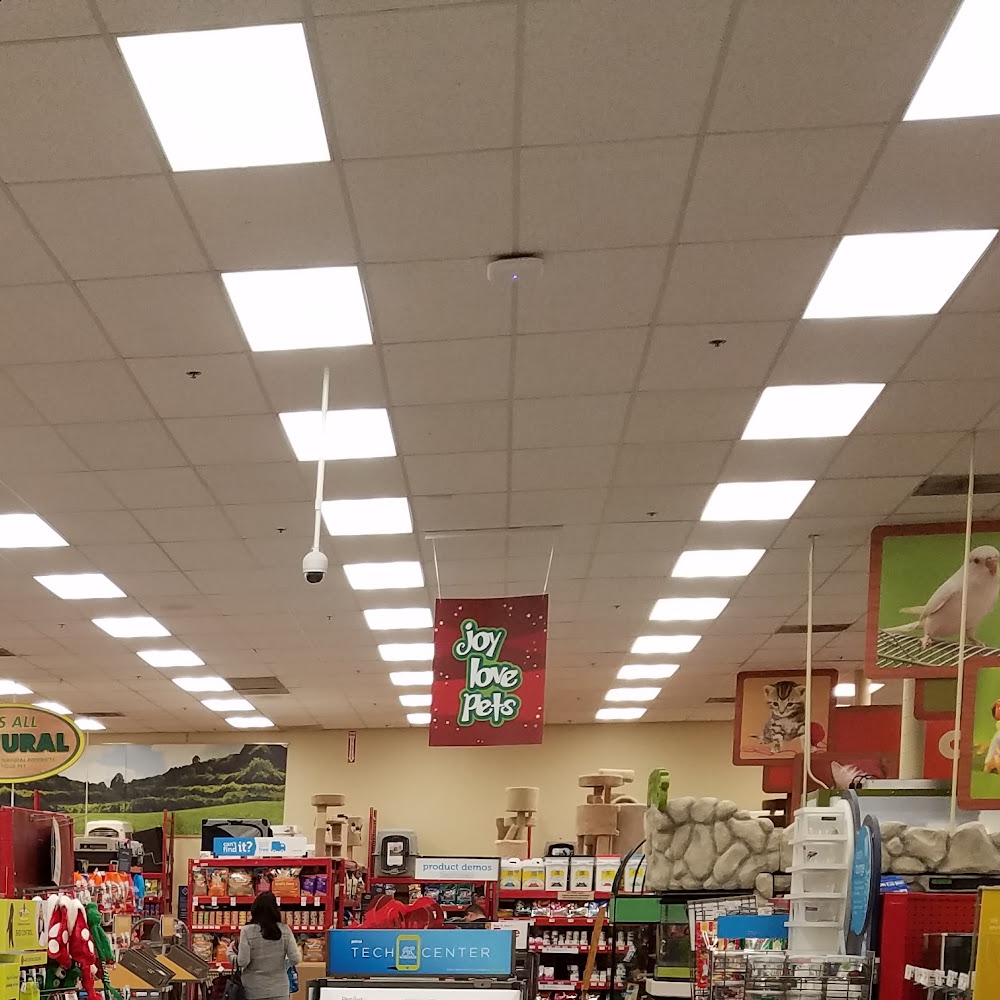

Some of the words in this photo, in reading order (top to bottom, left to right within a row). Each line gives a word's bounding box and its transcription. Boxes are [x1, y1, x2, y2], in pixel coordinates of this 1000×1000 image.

[456, 621, 502, 657] joy
[470, 657, 518, 688] love
[12, 716, 37, 728] ALL
[223, 845, 237, 853] find
[237, 841, 253, 852] it?
[422, 862, 459, 873] product
[461, 863, 492, 872] demos
[351, 947, 394, 958] TECH
[421, 948, 490, 958] CENTER
